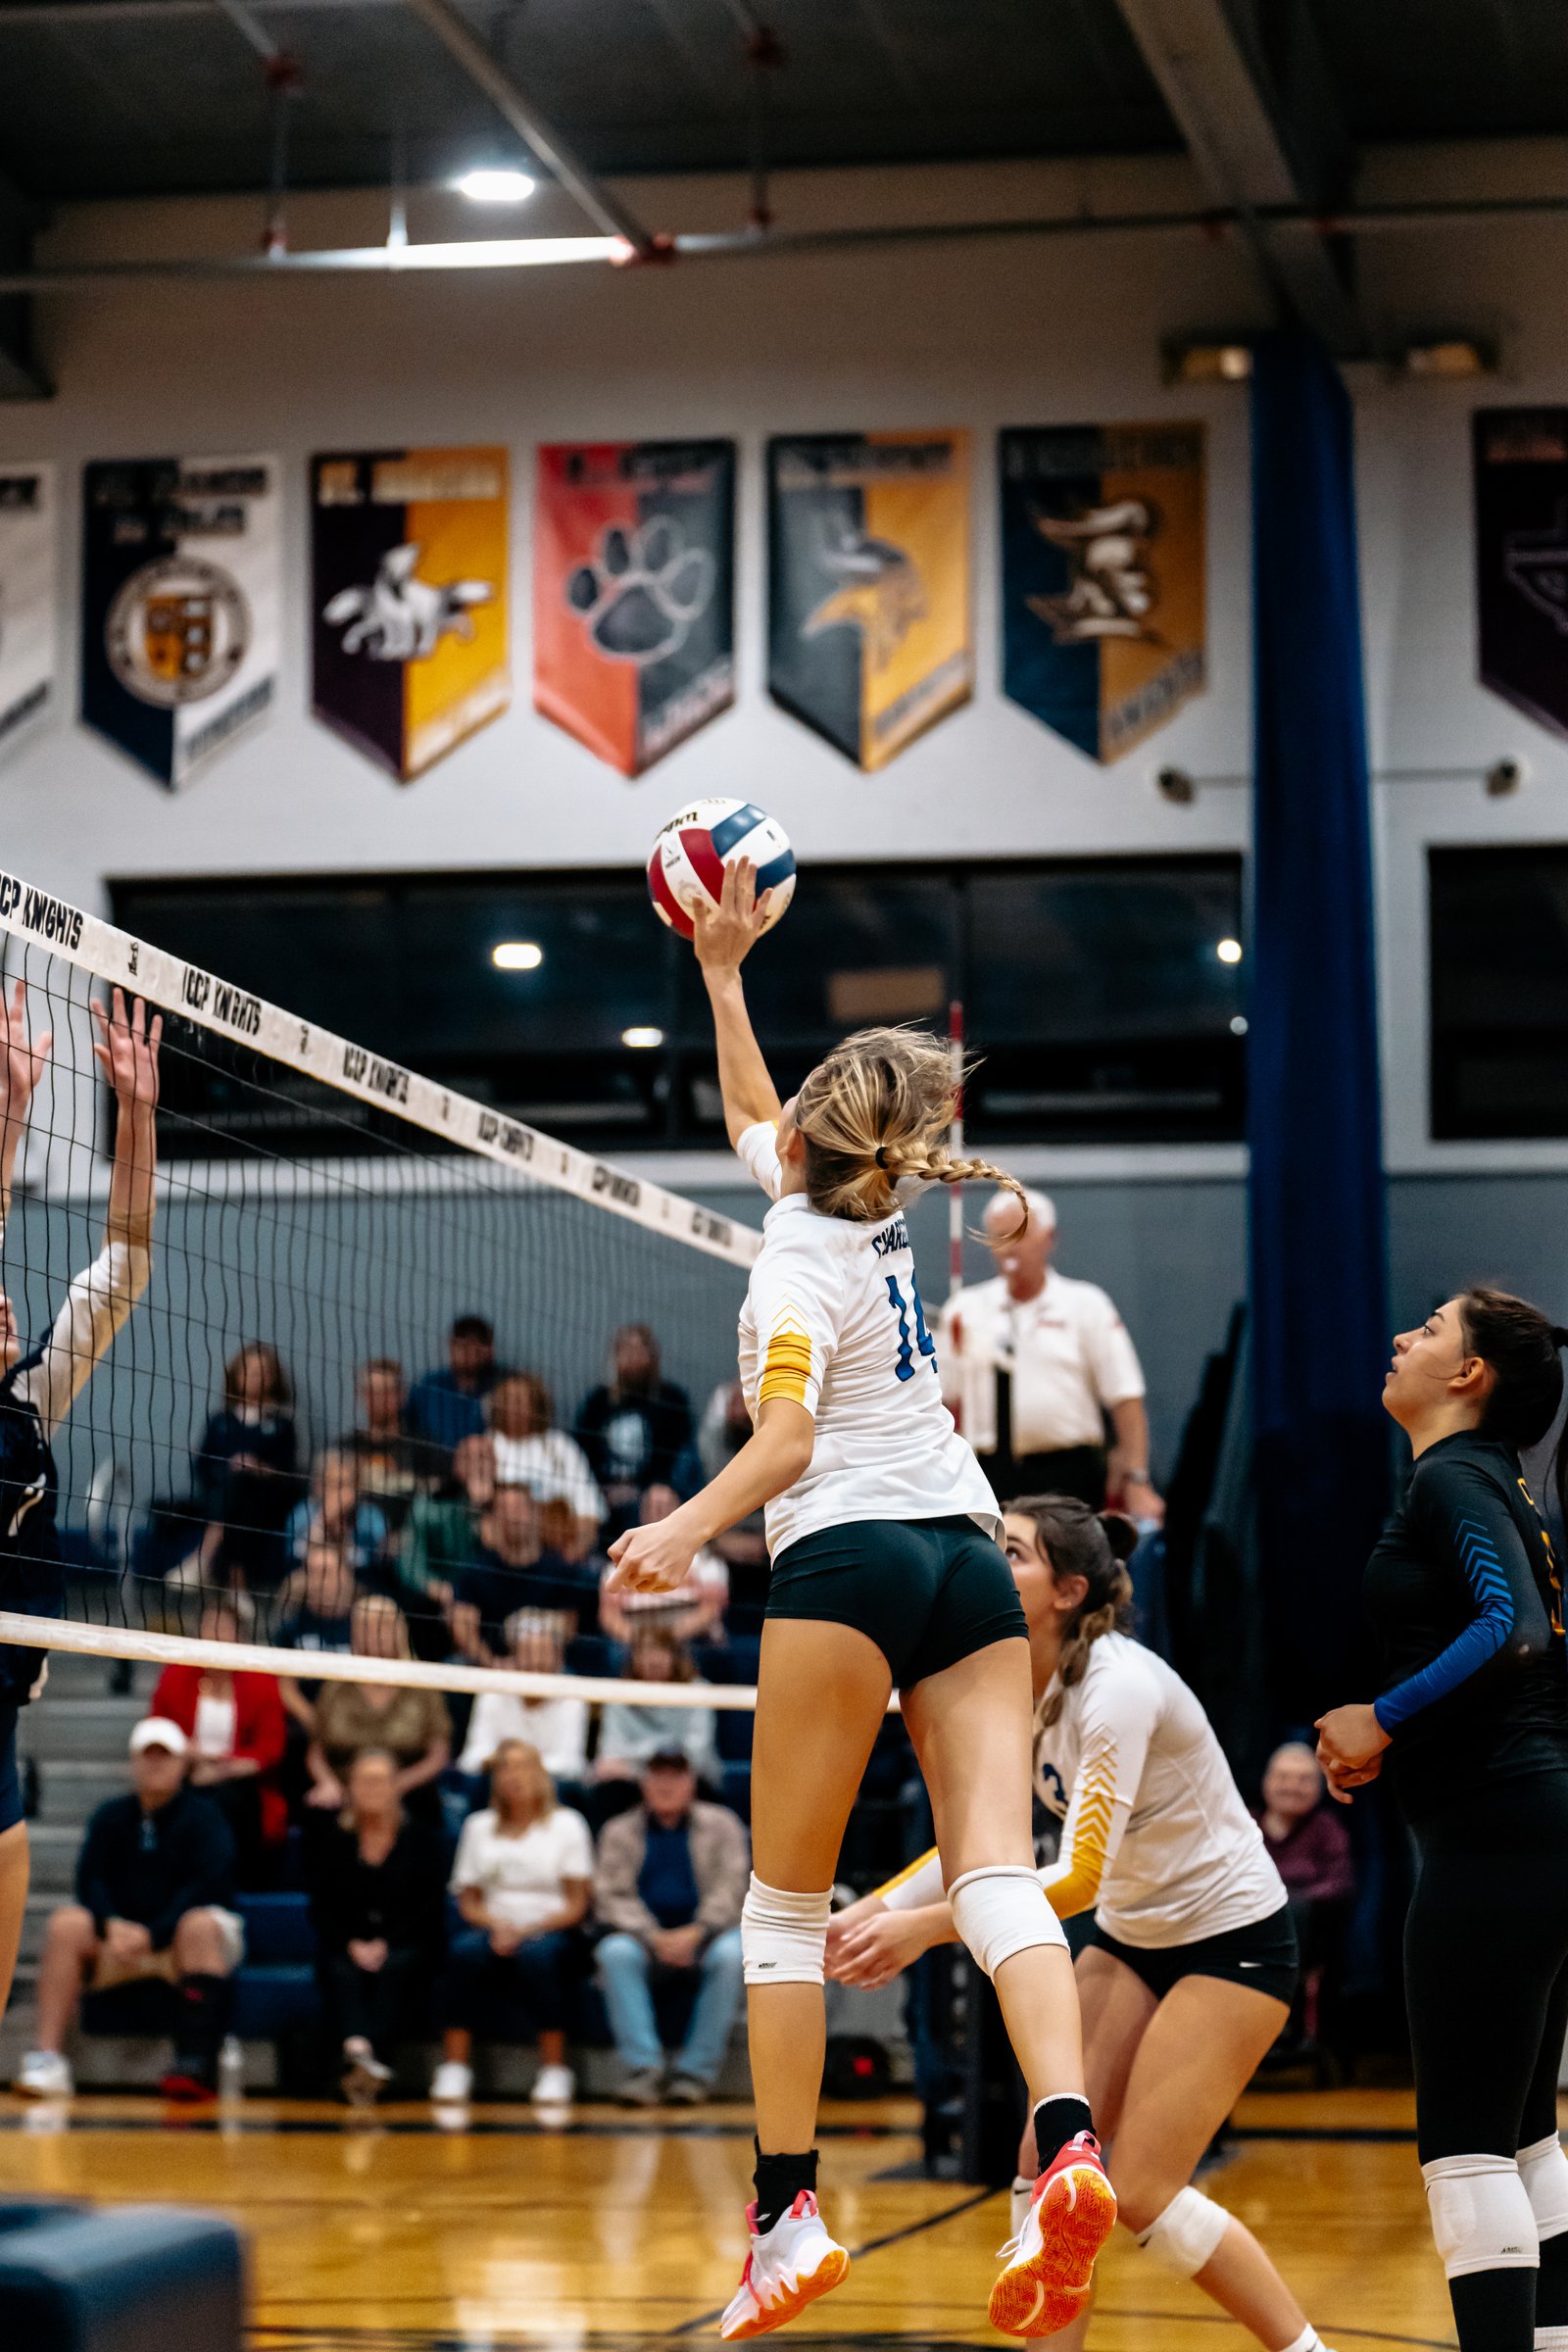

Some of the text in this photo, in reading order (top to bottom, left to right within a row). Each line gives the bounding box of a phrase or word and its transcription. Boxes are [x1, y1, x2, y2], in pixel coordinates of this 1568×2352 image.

[0, 872, 84, 950] CP KNIGHTS
[181, 966, 262, 1036] ICCP KNIGHTS
[885, 1268, 938, 1382] 14
